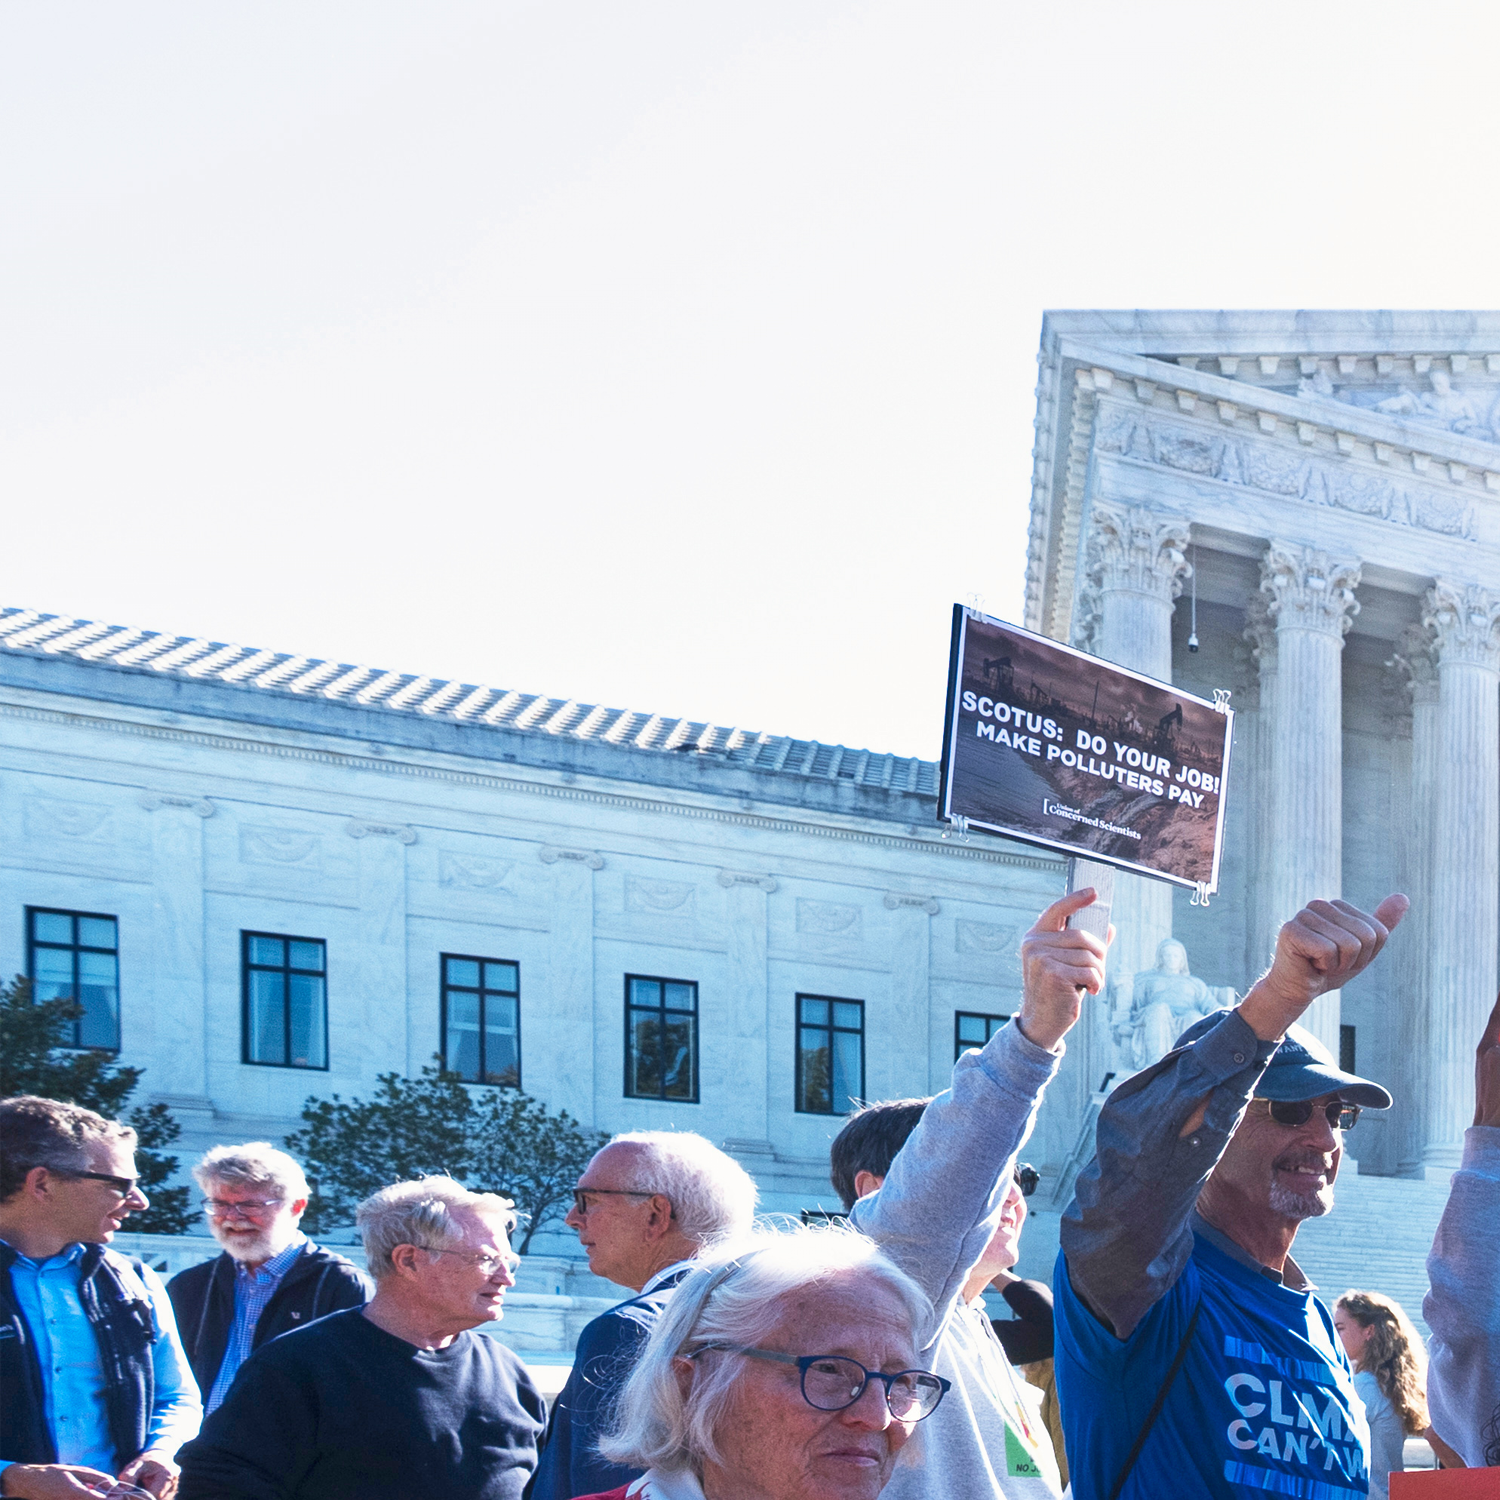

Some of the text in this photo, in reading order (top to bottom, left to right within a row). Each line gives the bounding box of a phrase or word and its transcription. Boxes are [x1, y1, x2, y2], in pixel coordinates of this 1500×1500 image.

[962, 690, 1221, 794] SCOTUS: DO YOUR JOB!
[977, 721, 1205, 809] MAKE POLLUTERS PAY
[1049, 804, 1142, 840] Concerned Scientists
